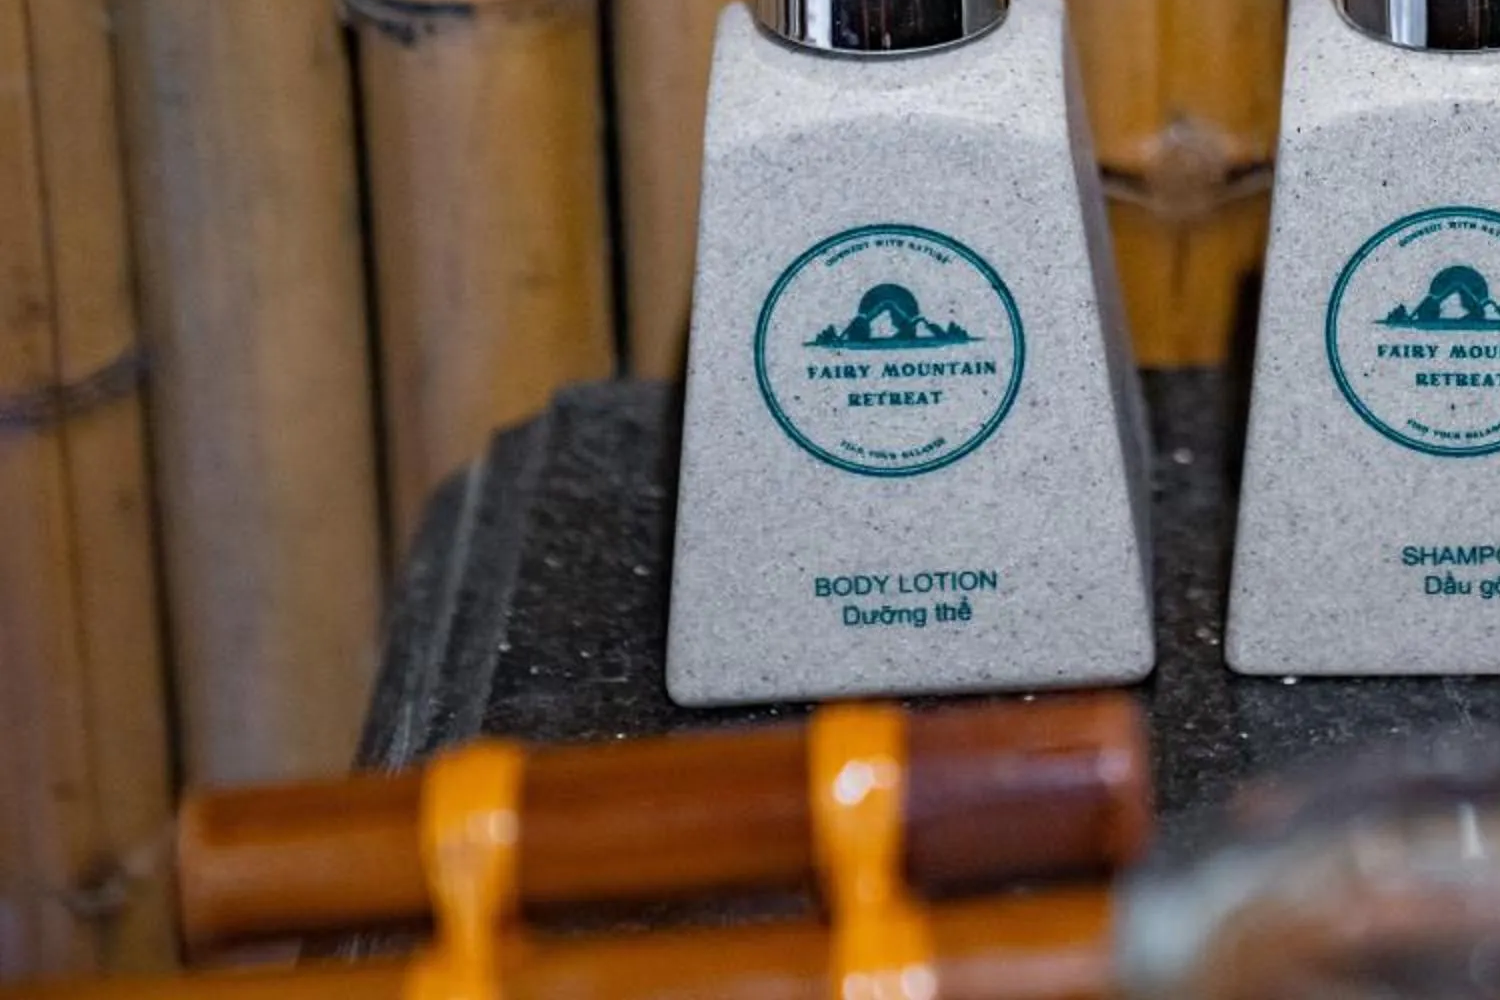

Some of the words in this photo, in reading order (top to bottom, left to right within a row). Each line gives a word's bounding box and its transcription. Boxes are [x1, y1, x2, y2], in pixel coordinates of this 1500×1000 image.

[1377, 344, 1439, 359] FAIRY
[807, 364, 870, 380] FAIRY
[882, 361, 997, 378] MOUNTAIN
[847, 390, 943, 407] RETREAT
[815, 574, 890, 597] BODY
[899, 570, 997, 594] LOTION
[1424, 570, 1472, 595] Dầu
[843, 604, 928, 628] Dưỡng
